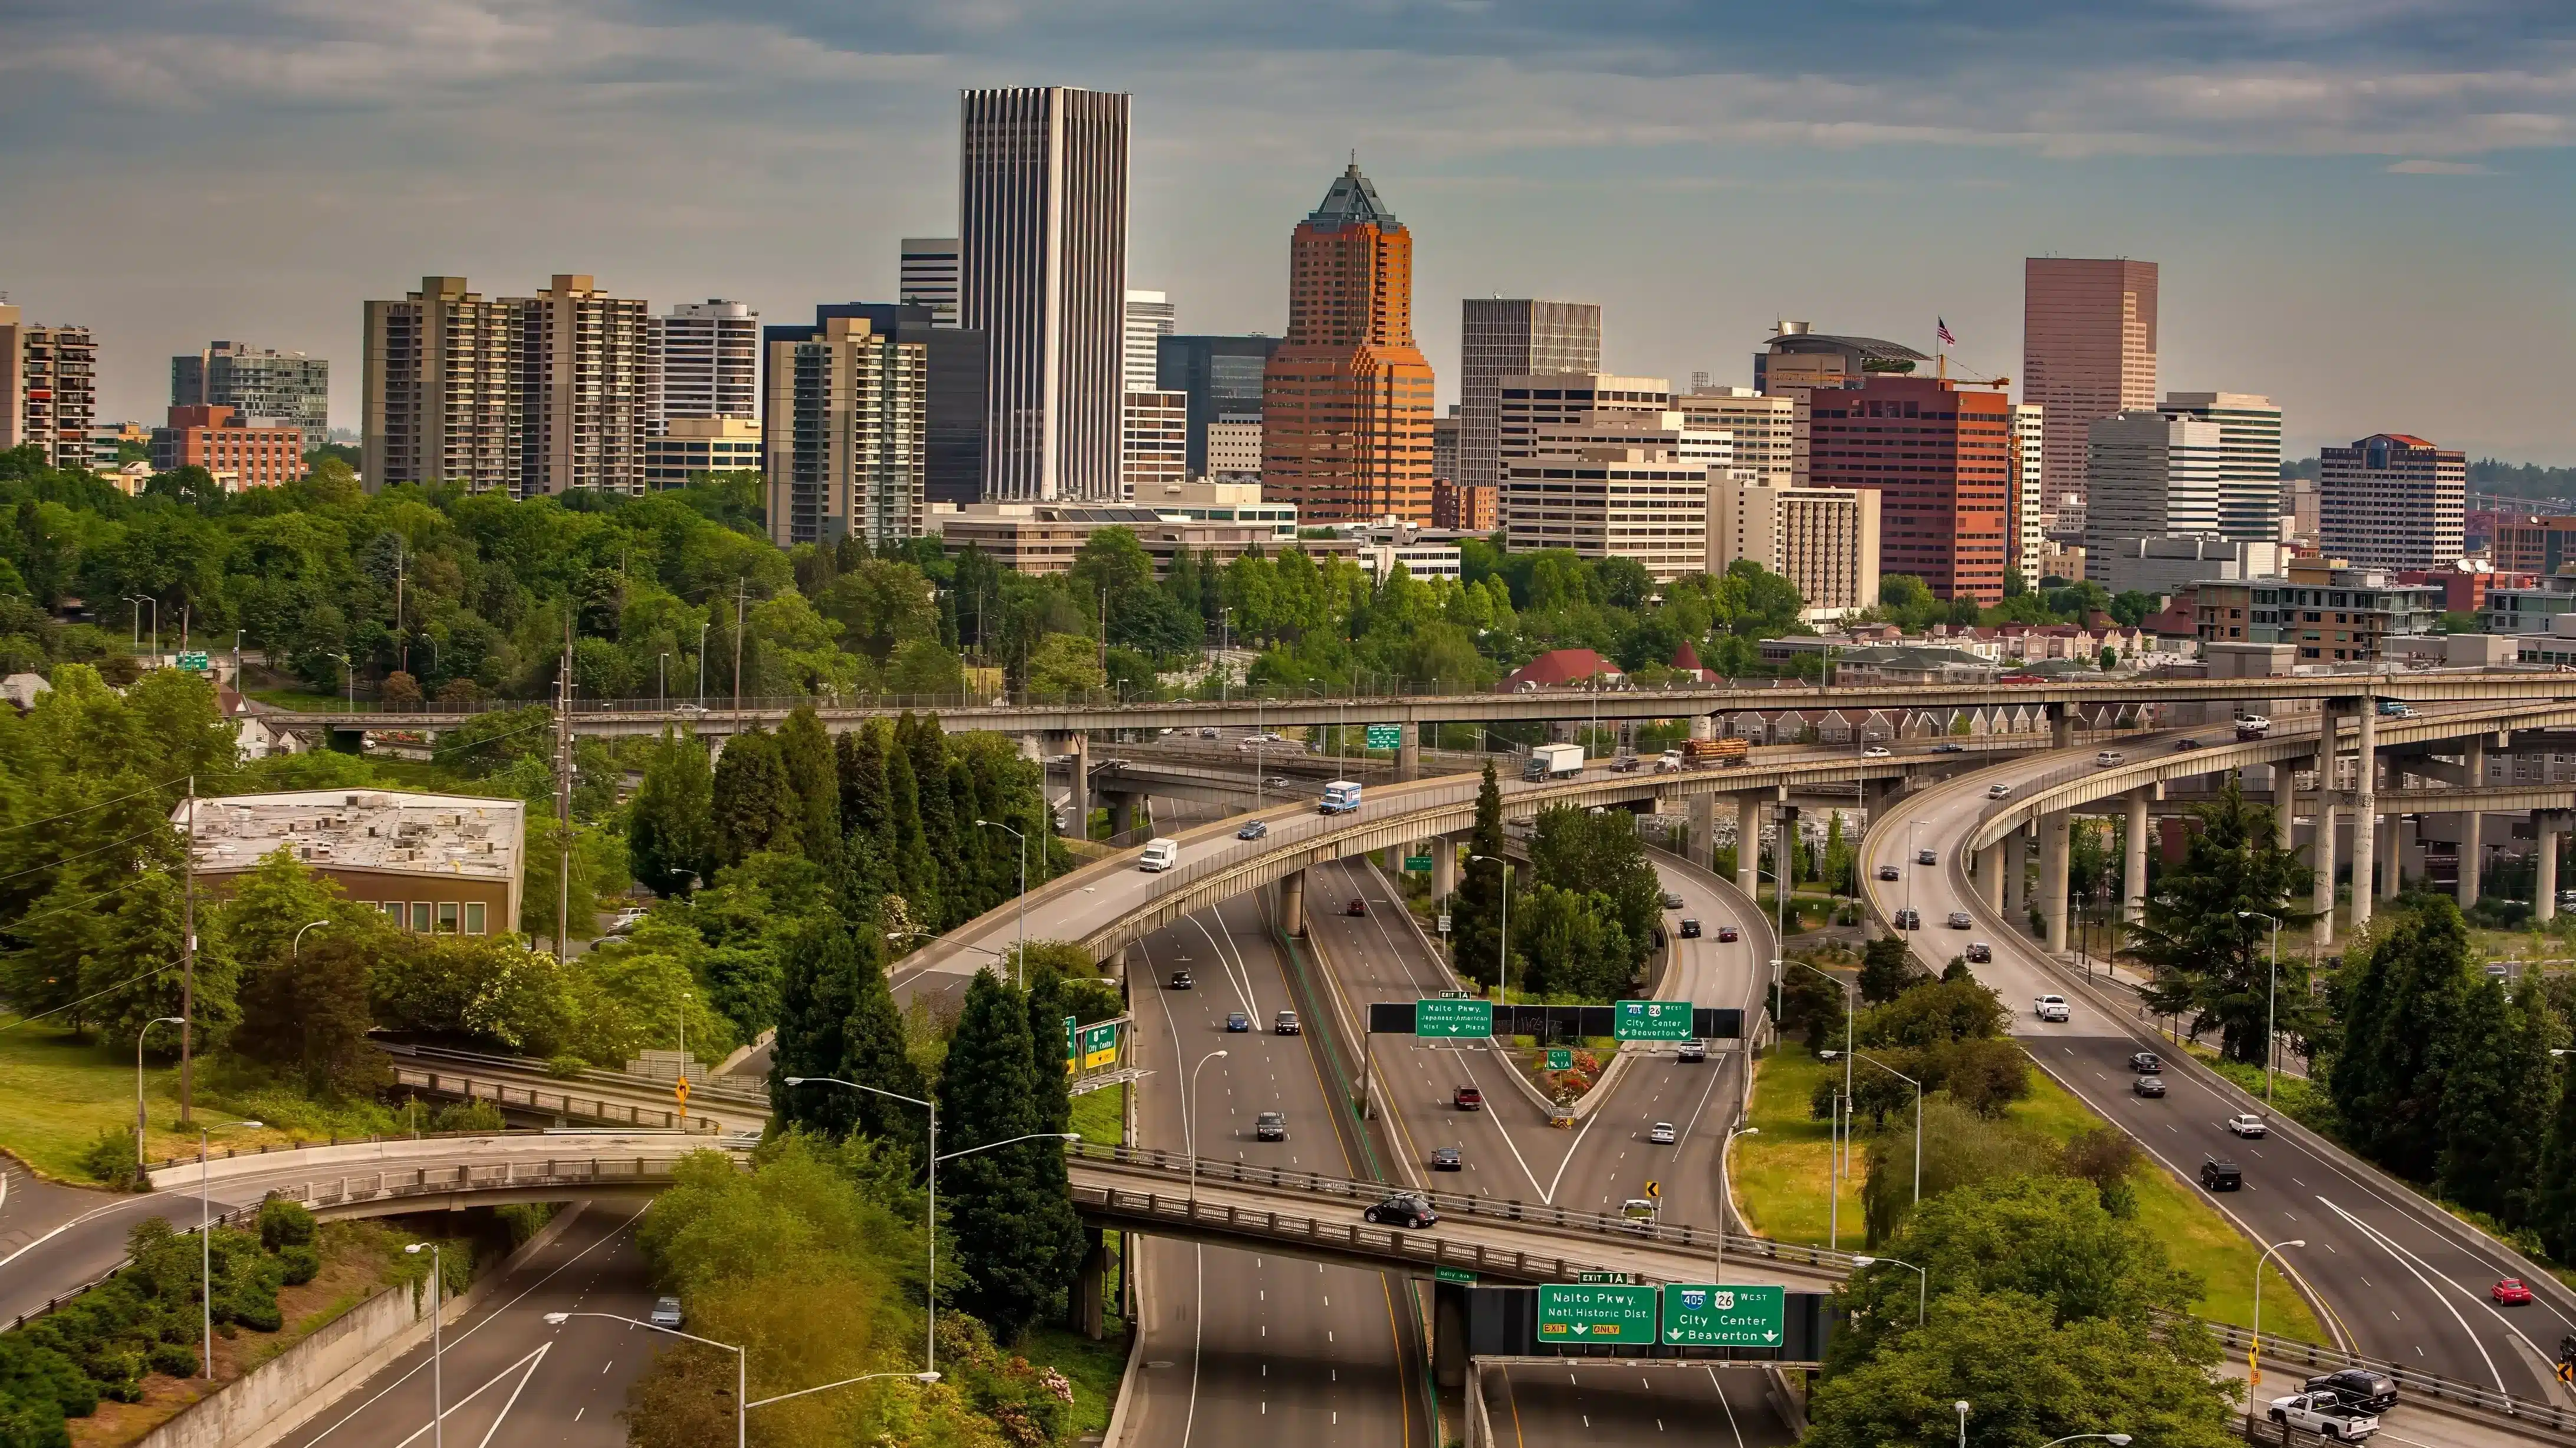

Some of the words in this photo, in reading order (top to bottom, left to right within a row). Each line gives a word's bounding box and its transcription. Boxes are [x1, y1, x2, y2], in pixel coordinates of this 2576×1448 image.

[1609, 1273, 1623, 1284] 1A
[1553, 1292, 1589, 1302] Naito
[1597, 1294, 1636, 1305] Pkwy.
[1684, 1295, 1703, 1305] 405
[1718, 1295, 1732, 1307] 26
[1576, 1309, 1619, 1318] Historic
[1625, 1309, 1648, 1318] Dist.
[1680, 1315, 1708, 1327] City
[1720, 1315, 1767, 1325] Center
[1688, 1330, 1757, 1340] Beaverton
